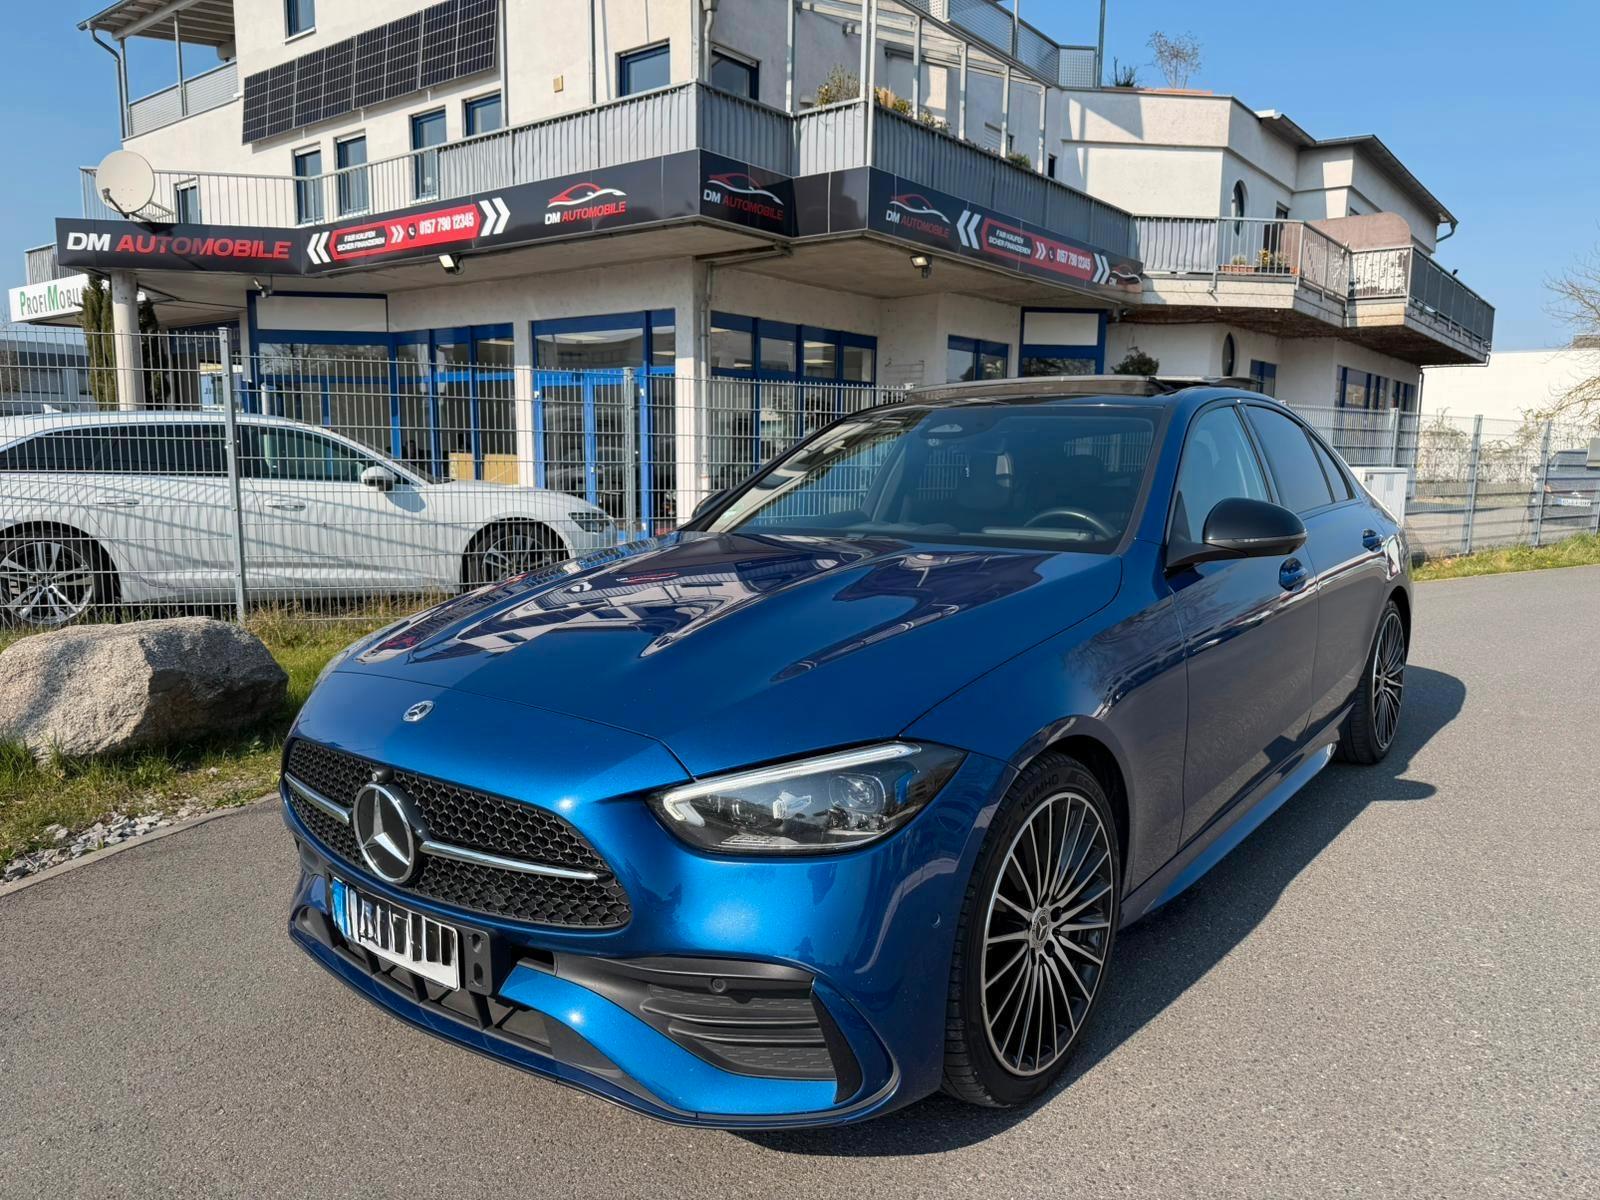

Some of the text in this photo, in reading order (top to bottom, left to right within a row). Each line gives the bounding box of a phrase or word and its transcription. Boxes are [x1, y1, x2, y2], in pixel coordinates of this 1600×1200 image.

[544, 201, 627, 225] DM AUTOMOBILE
[703, 188, 784, 221] DM AUTOMOBILE
[419, 219, 436, 235] 0157
[885, 208, 950, 239] DM AUTOMOBILE
[66, 232, 292, 260] DM AUTOMOBILE
[1021, 774, 1059, 811] KUMHO
